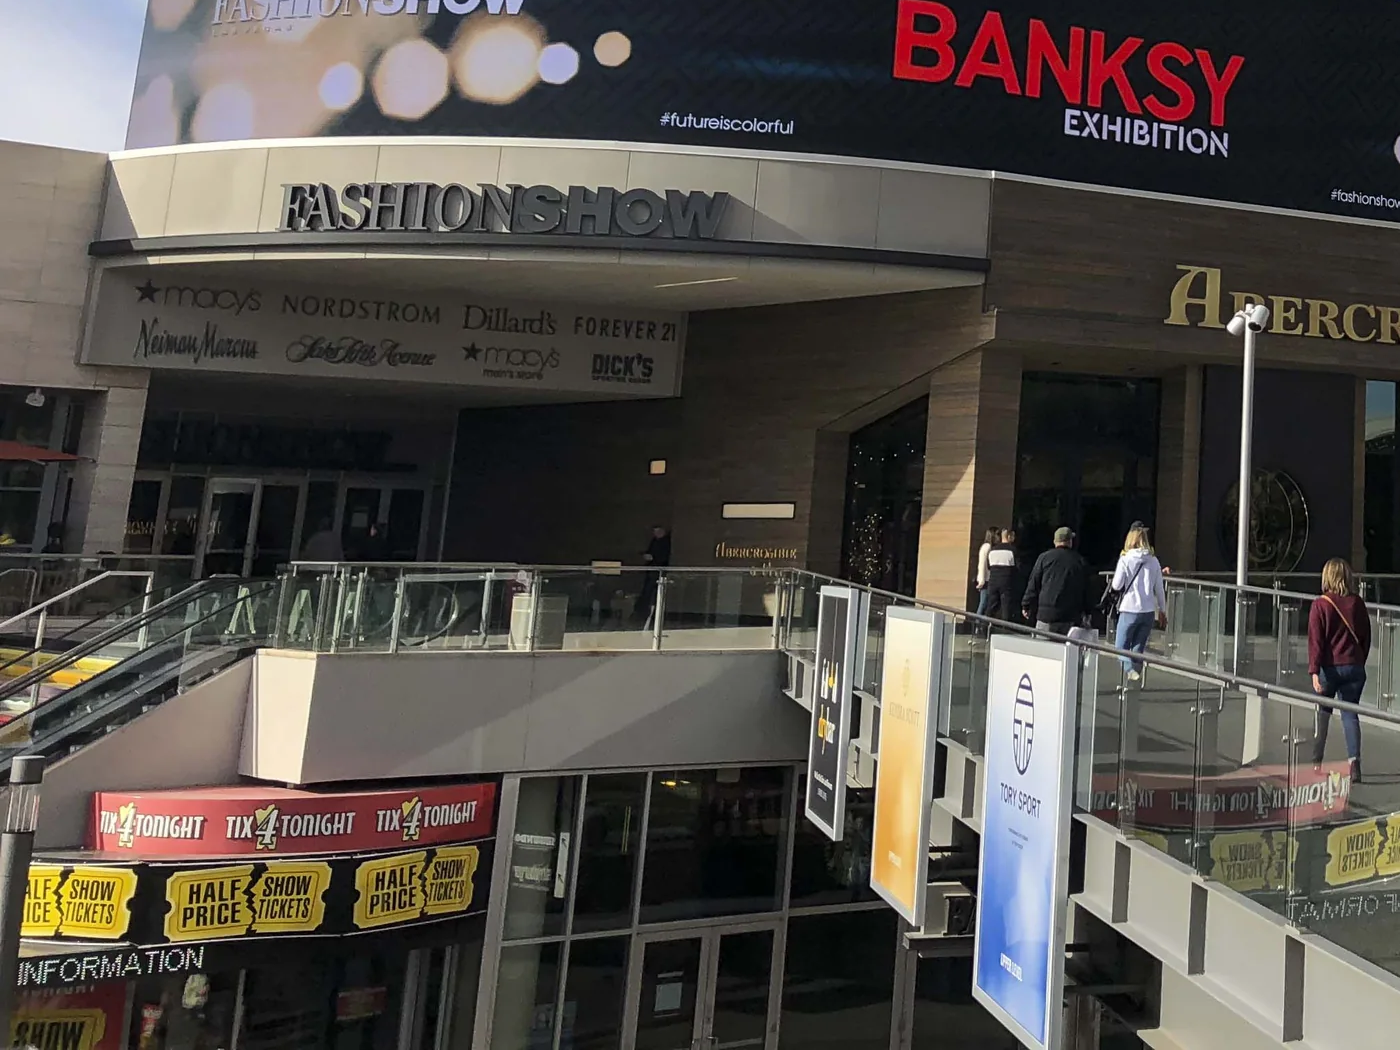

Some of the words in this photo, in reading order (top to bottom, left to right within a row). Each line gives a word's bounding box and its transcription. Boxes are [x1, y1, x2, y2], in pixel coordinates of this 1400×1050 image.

[659, 112, 794, 135] #futureiscolorful
[1063, 108, 1229, 158] EXHIBITION
[164, 285, 262, 316] macy's
[282, 295, 440, 325] NORDSTROM
[462, 304, 558, 335] Dillard's
[574, 316, 657, 341] FOREVER
[661, 322, 677, 342] 21
[134, 317, 198, 364] Neiman
[200, 321, 259, 360] Marcus
[484, 346, 560, 371] macy's
[591, 352, 654, 378] DICK'S
[1000, 782, 1017, 807] TORY
[1018, 791, 1041, 818] SPORT
[374, 864, 417, 892] HALF
[432, 858, 467, 881] SHOW
[69, 879, 116, 901] SHOW
[188, 879, 242, 905] HALF
[262, 875, 312, 897] SHOW
[429, 879, 465, 902] TICKETS
[26, 902, 52, 923] ICE
[65, 901, 115, 925] TICKETS
[258, 896, 311, 920] TICKETS
[369, 886, 417, 915] PRICE
[182, 902, 242, 928] PRICE
[17, 946, 205, 987] INFORMATION
